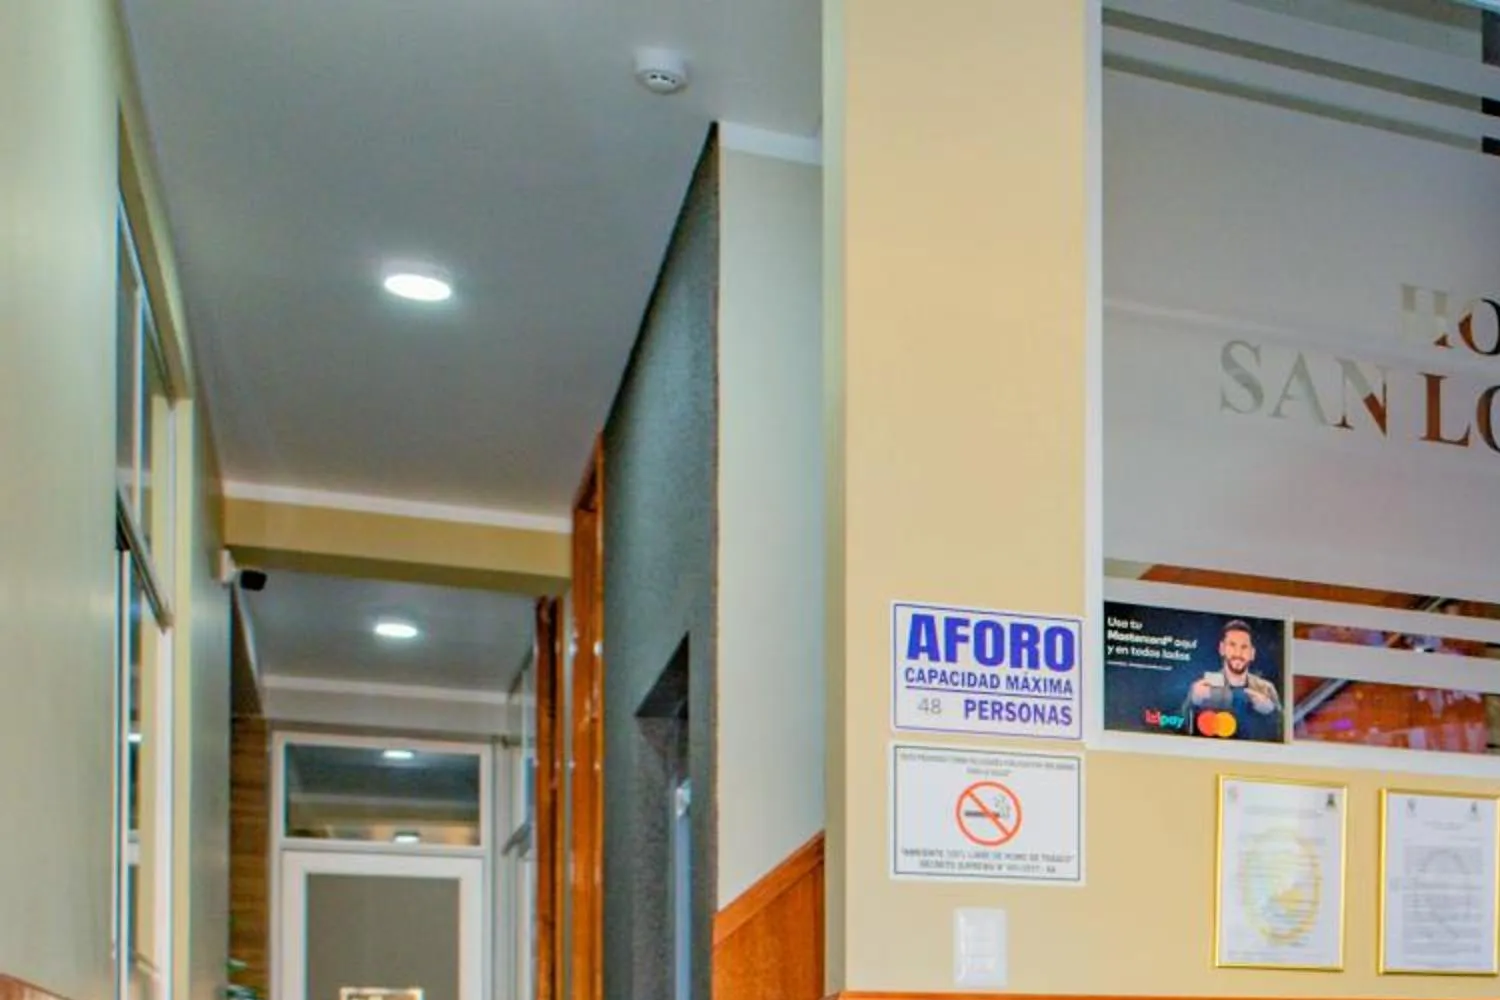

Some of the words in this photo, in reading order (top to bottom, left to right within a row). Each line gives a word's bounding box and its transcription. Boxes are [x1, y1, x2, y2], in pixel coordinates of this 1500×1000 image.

[1219, 339, 1394, 438] SAN
[1107, 616, 1129, 629] Use
[1129, 619, 1143, 630] tu
[906, 613, 1075, 672] AFORO
[1107, 645, 1115, 655] y
[1115, 646, 1129, 655] en
[1130, 646, 1161, 658] todos
[1161, 650, 1191, 661] lados
[905, 667, 1000, 690] CAPACIDAD
[1005, 671, 1073, 695] MÁXIMA
[917, 697, 942, 715] 48
[963, 699, 1073, 726] PERSONAS
